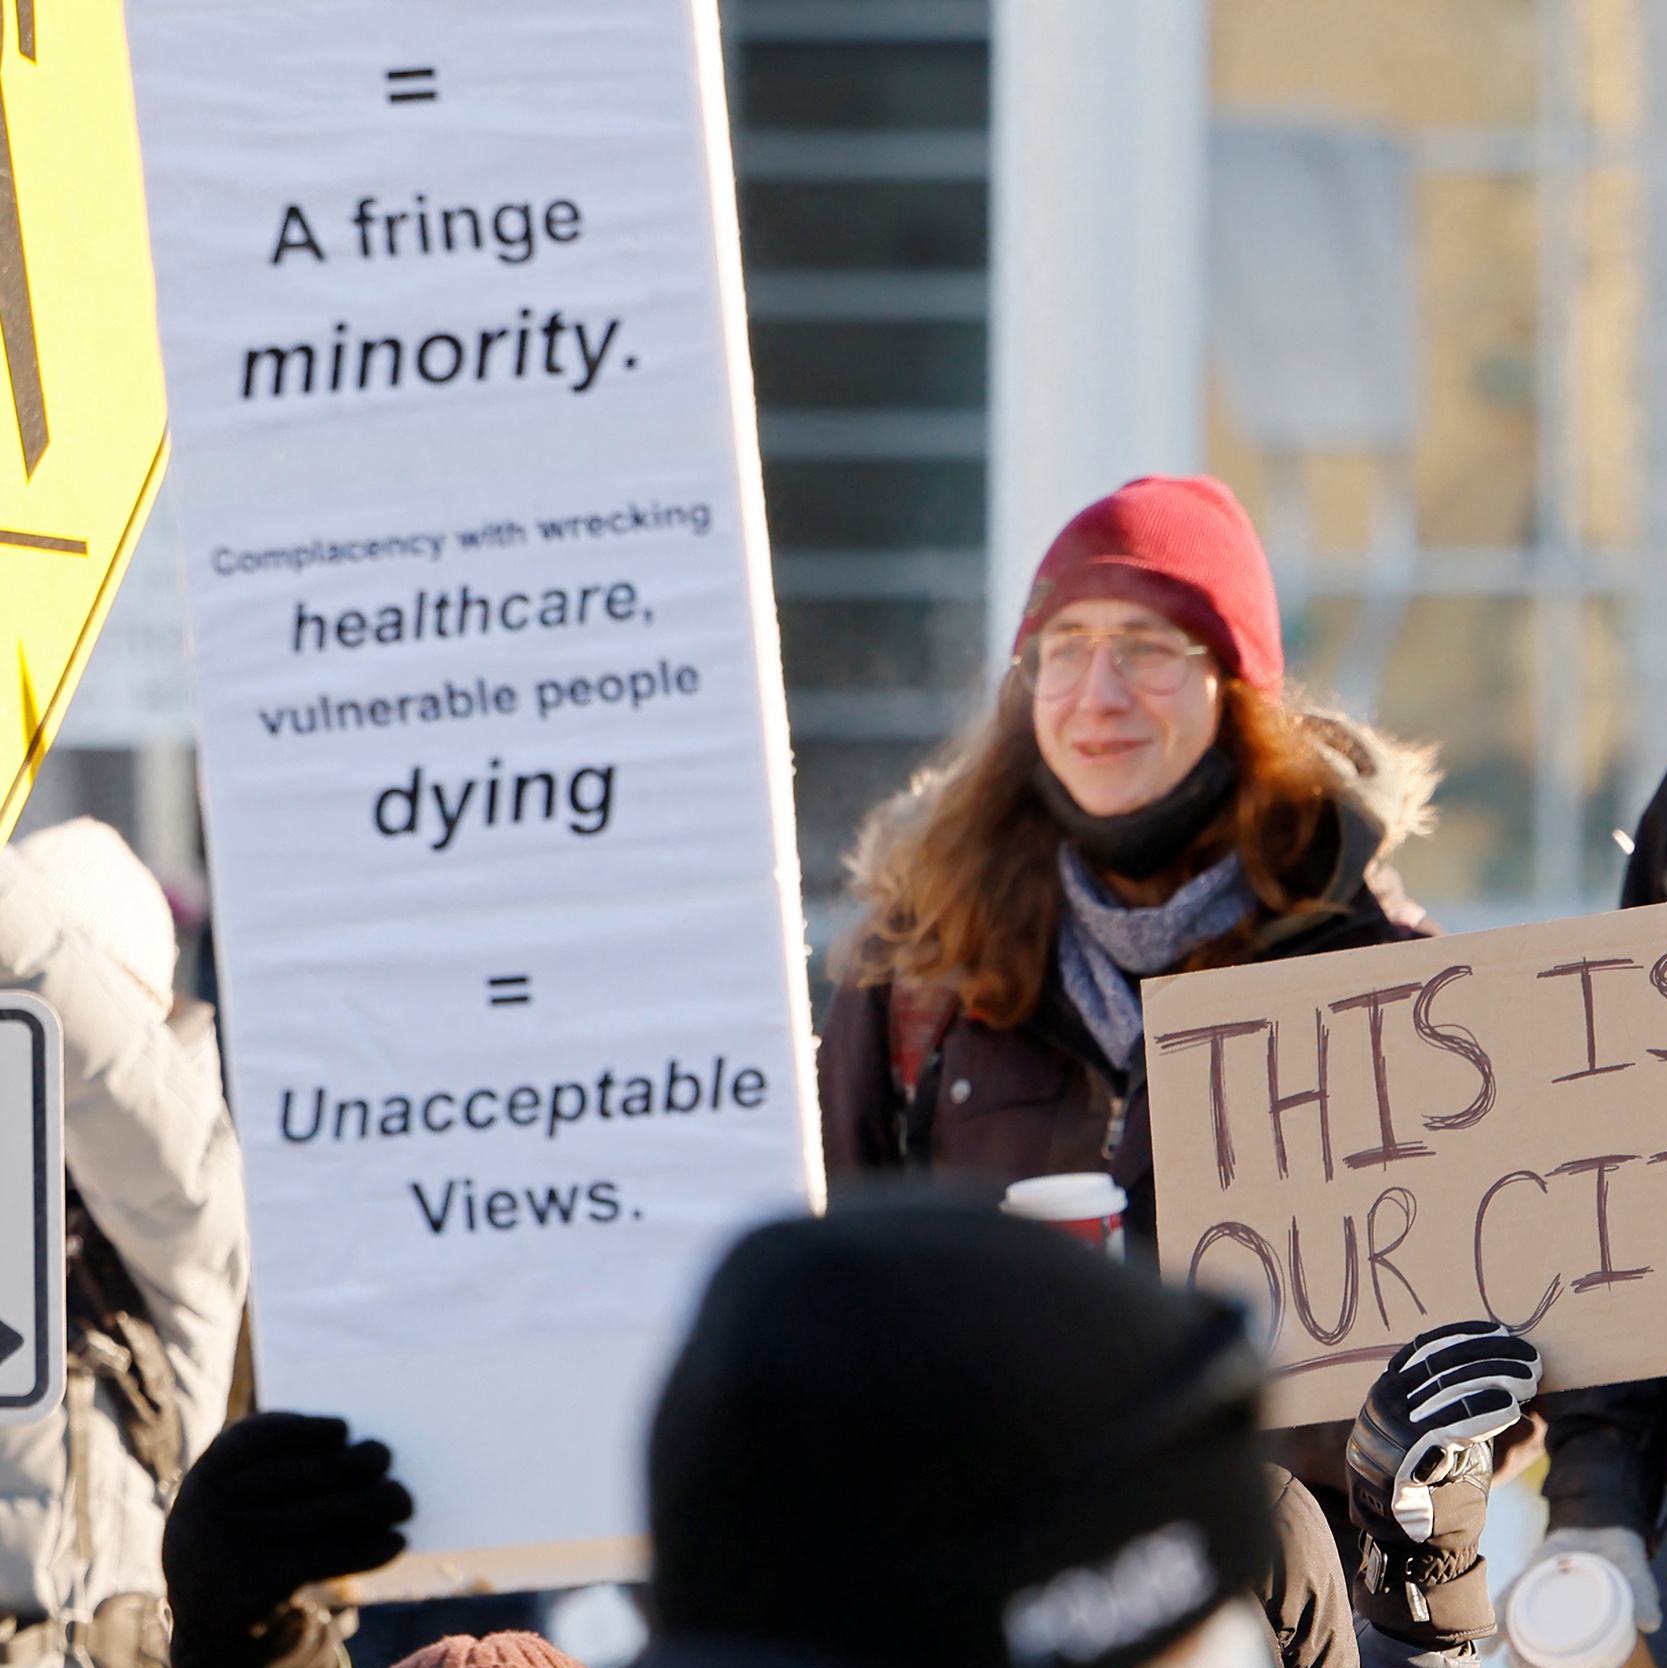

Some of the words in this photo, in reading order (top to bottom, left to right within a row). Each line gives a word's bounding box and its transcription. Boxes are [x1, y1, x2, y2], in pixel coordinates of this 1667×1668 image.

[270, 203, 327, 267] A
[351, 193, 583, 265] fringe
[241, 307, 639, 401] minority.
[211, 533, 447, 578] Complacency
[456, 520, 528, 550] with
[536, 503, 713, 542] wrecking
[291, 581, 655, 655] healthcare,
[258, 677, 519, 738] vulnerable
[534, 659, 701, 719] people
[372, 757, 618, 851] dying
[279, 1055, 769, 1144] Unacceptable
[1155, 965, 1496, 1193] THIS
[408, 1178, 644, 1237] Views.
[1188, 1186, 1428, 1352] OUR
